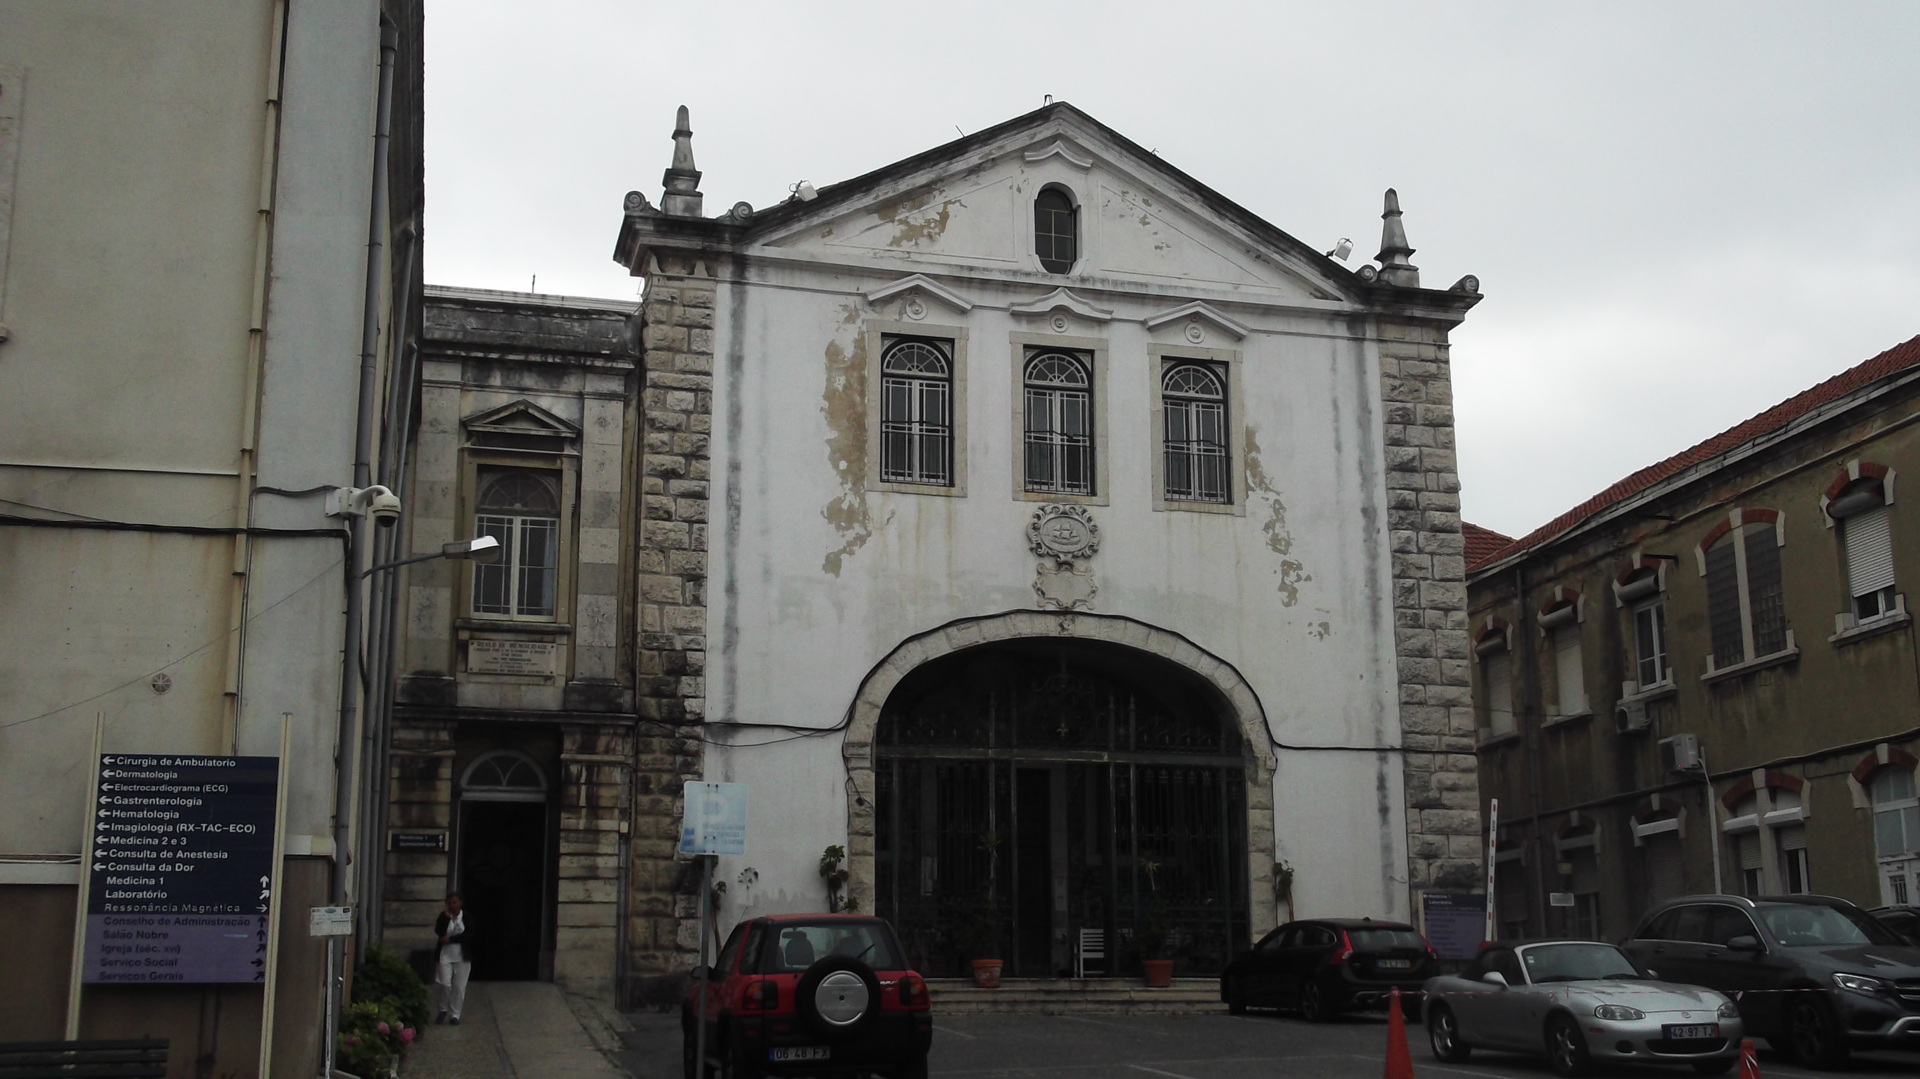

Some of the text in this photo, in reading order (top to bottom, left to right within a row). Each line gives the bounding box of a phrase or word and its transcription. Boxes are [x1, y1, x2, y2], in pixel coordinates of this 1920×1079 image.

[116, 756, 236, 768] Cirurgia de Ambulatorio
[115, 769, 178, 780] Dermatologia
[114, 784, 229, 794] Electrocardiograma (ECG)
[113, 796, 202, 807] Gastrenterologia
[112, 809, 180, 820] Hematologia
[111, 822, 256, 834] Imagiologia (RX-TAC-ECO)
[110, 836, 158, 845] Medicina
[161, 836, 168, 845] 2
[180, 837, 187, 846] 3
[109, 849, 228, 859] Consulta de Anestesia
[108, 862, 194, 872] Consulta da Dor
[106, 876, 164, 885] Medicina 1
[105, 889, 168, 899] Laboratório
[104, 902, 240, 914] Ressonância Magnética
[104, 916, 250, 928] Conselho de Administração
[102, 929, 169, 939] Salão Nobre
[102, 944, 133, 954] Igreja
[100, 958, 178, 968] Serviço Social
[99, 971, 184, 981] Serviços Gerais
